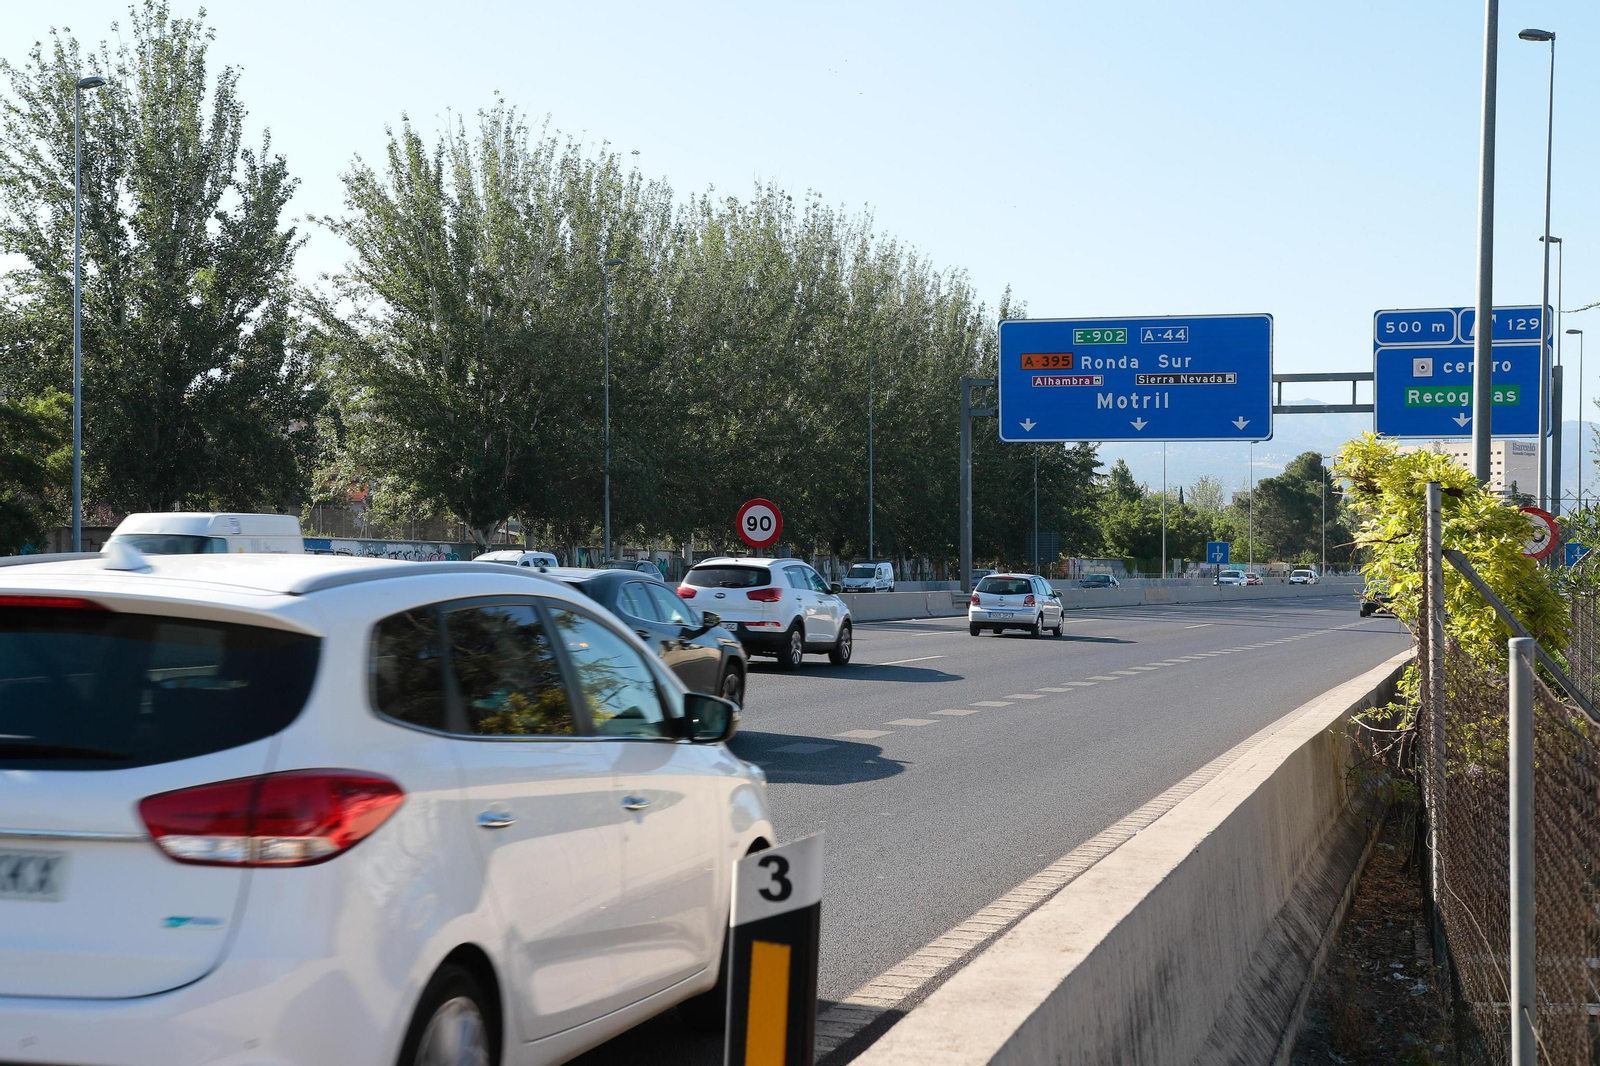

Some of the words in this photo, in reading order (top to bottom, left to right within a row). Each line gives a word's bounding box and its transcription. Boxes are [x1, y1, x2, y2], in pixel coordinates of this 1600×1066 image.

[1385, 321, 1422, 334] 500
[1431, 322, 1446, 333] m
[1507, 318, 1540, 331] 129
[1075, 330, 1126, 343] E-902
[1143, 328, 1186, 341] A-44
[1024, 355, 1071, 368] A-395
[1081, 355, 1139, 370] Ronda
[1158, 354, 1192, 369] Sur
[1443, 360, 1512, 374] cenro
[1034, 376, 1091, 386] Alhambra
[1138, 375, 1175, 385] Sierra
[1180, 374, 1223, 384] Nevada
[1097, 392, 1170, 410] Motril
[1408, 389, 1517, 407] Recogas
[746, 515, 772, 532] 90
[757, 854, 793, 902] 3
